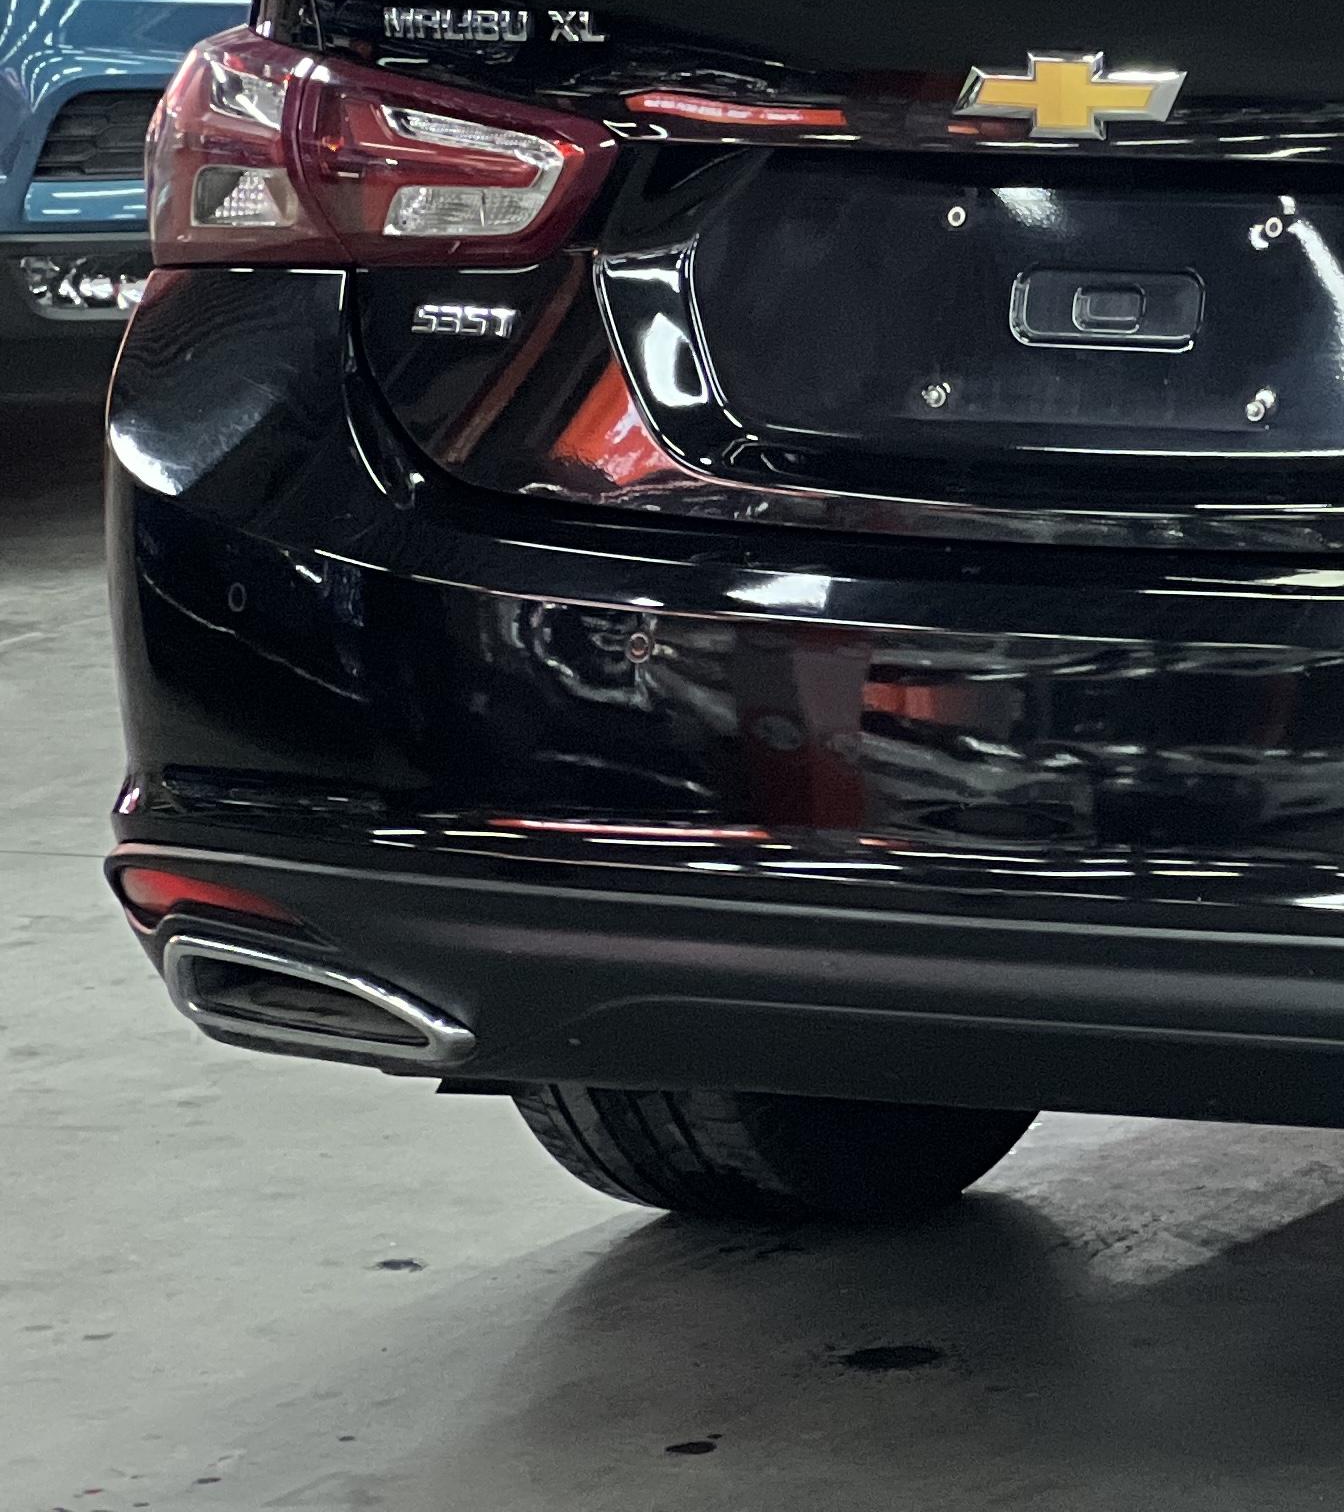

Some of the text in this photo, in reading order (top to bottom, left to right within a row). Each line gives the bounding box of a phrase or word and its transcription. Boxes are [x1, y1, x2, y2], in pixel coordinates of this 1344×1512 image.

[383, 6, 606, 43] MALIBU XL
[411, 303, 522, 339] 535T
